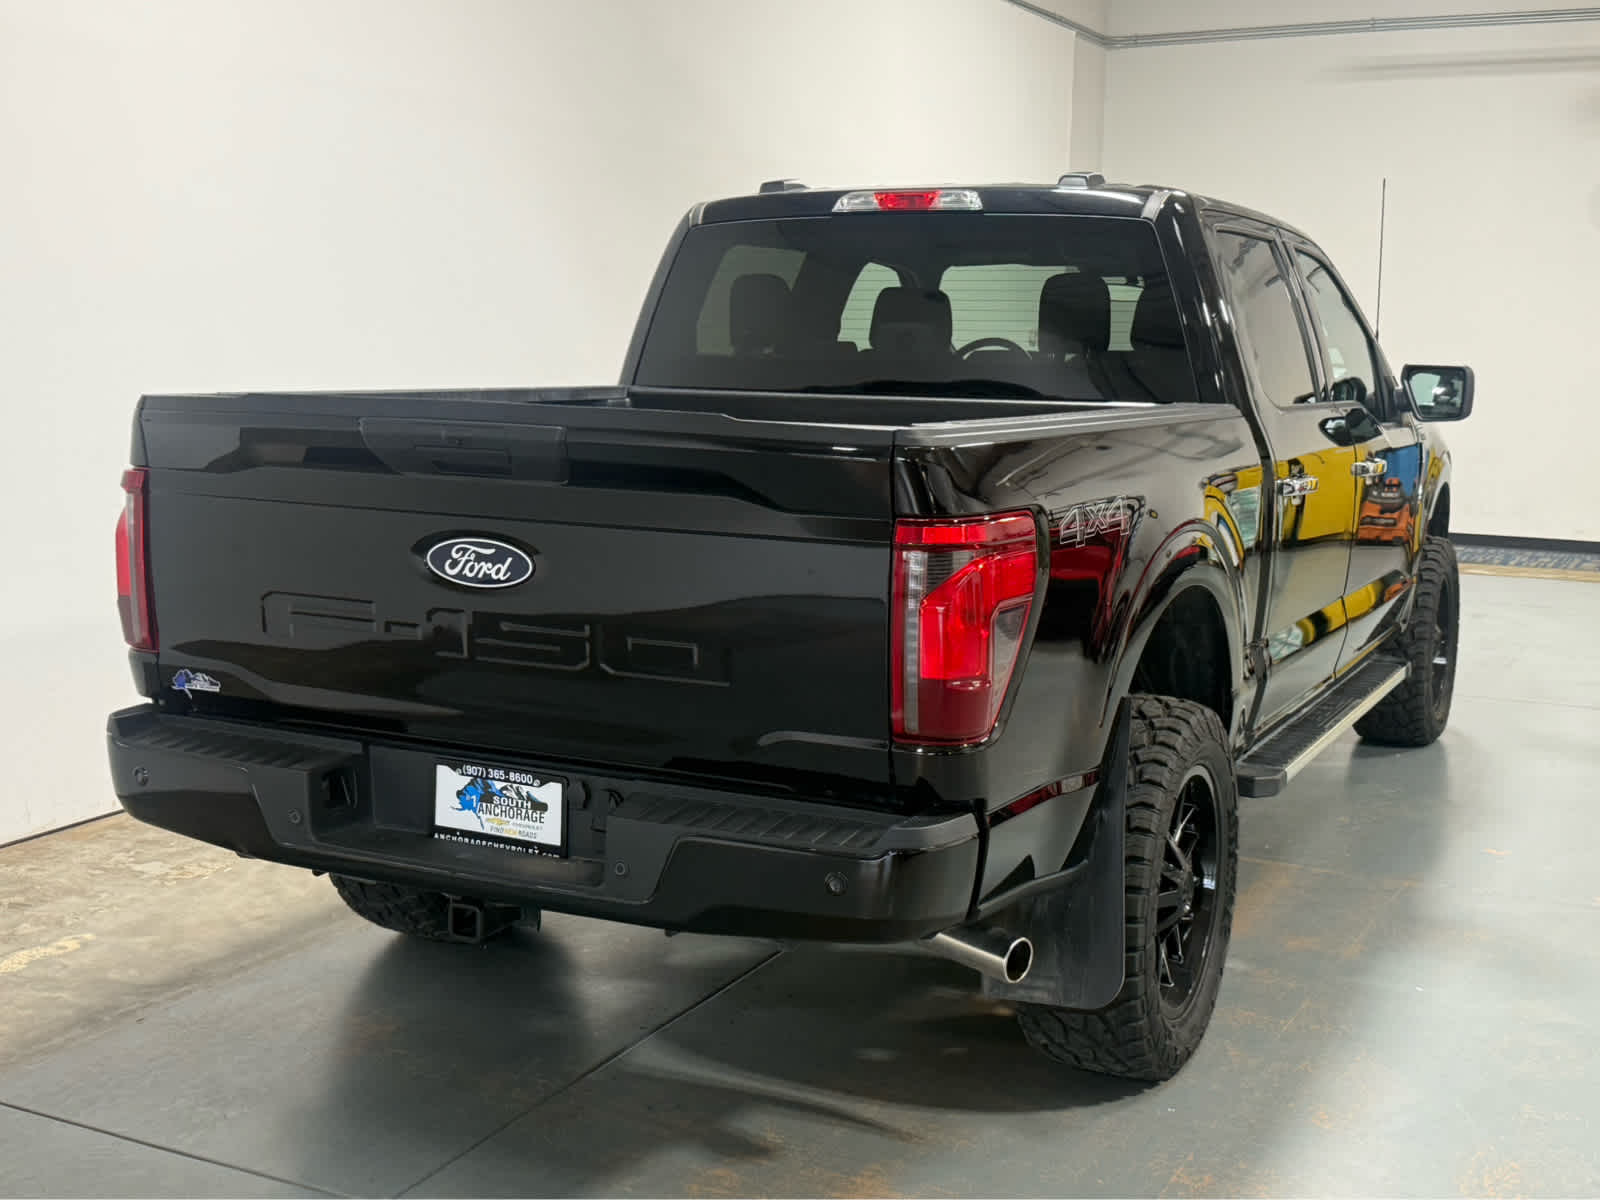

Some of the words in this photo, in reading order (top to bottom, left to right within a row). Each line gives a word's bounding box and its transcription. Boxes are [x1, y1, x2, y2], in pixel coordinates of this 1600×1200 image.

[444, 542, 511, 581] Ford
[261, 591, 731, 687] F-150
[462, 764, 486, 777] (907)
[488, 768, 533, 785] 365-8600
[478, 802, 545, 824] ANCHORAGE
[492, 795, 532, 809] SOUTH
